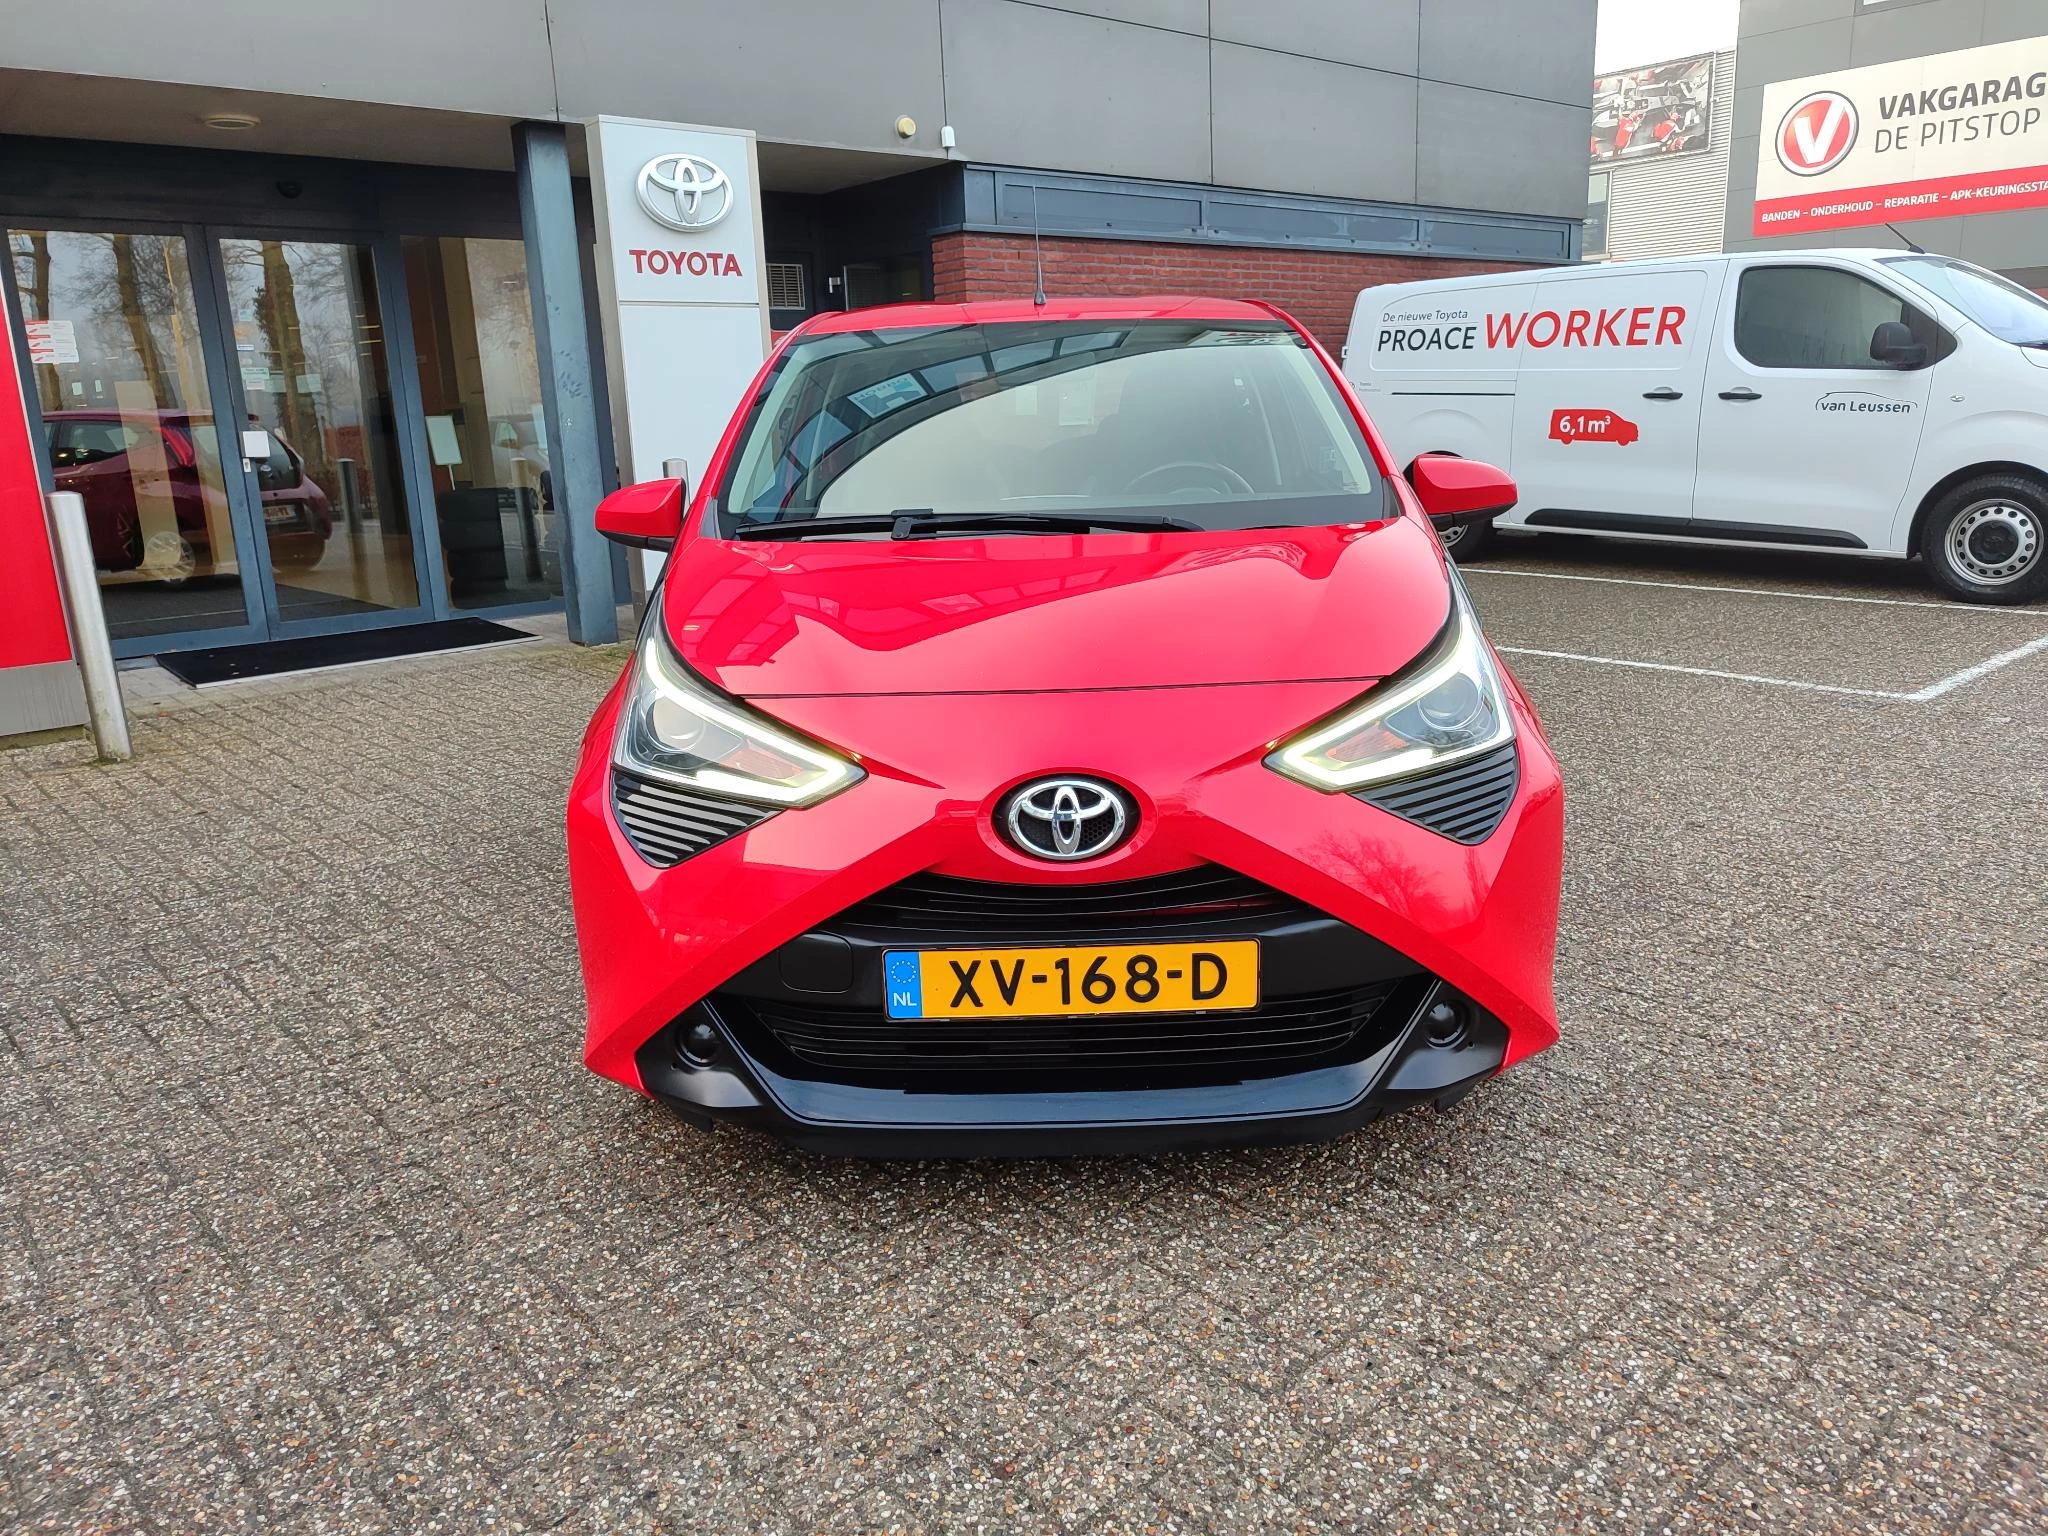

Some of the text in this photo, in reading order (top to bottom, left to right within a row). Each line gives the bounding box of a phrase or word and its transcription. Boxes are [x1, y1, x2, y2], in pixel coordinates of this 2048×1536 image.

[1875, 107, 2041, 153] DE PITSTOP
[1761, 208, 1801, 223] BANDEN
[1811, 200, 1873, 216] ONDERHOUD
[1884, 192, 1939, 209] REPARATIE
[628, 249, 743, 277] TOYOTA
[1377, 305, 1687, 352] PROACE WORKER
[1382, 309, 1469, 323] De nieuwe Toyota
[1821, 400, 1911, 414] van Leussen
[948, 952, 1228, 1008] XV-168-D
[893, 992, 918, 1007] NL
